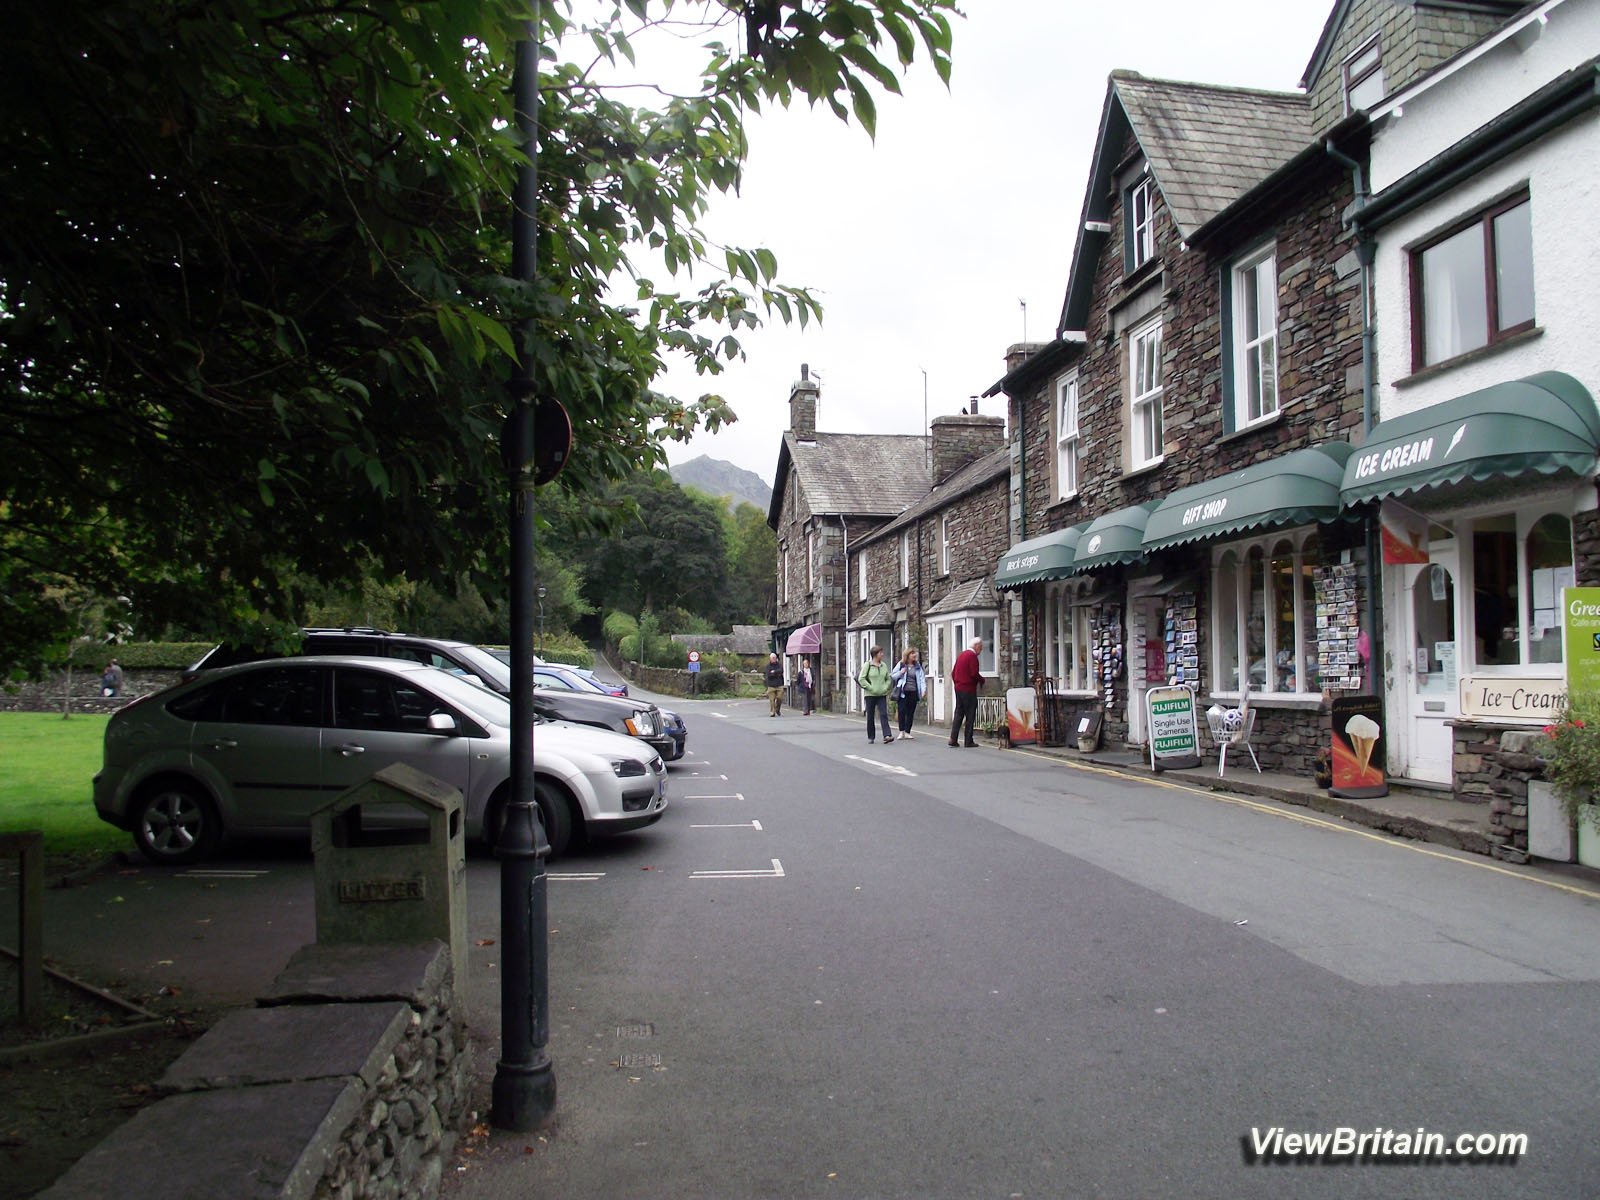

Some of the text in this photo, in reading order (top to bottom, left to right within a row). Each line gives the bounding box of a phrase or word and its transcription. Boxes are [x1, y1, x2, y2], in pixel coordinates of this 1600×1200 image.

[1355, 438, 1434, 479] ICE CREAM
[1182, 498, 1227, 525] GIFT SHOP
[1481, 687, 1566, 710] Ice-Cream
[1152, 701, 1189, 712] FUJIFILM
[1154, 718, 1191, 728] Single Use
[1157, 728, 1189, 736] Cameras
[1155, 738, 1191, 749] FUJIFILM
